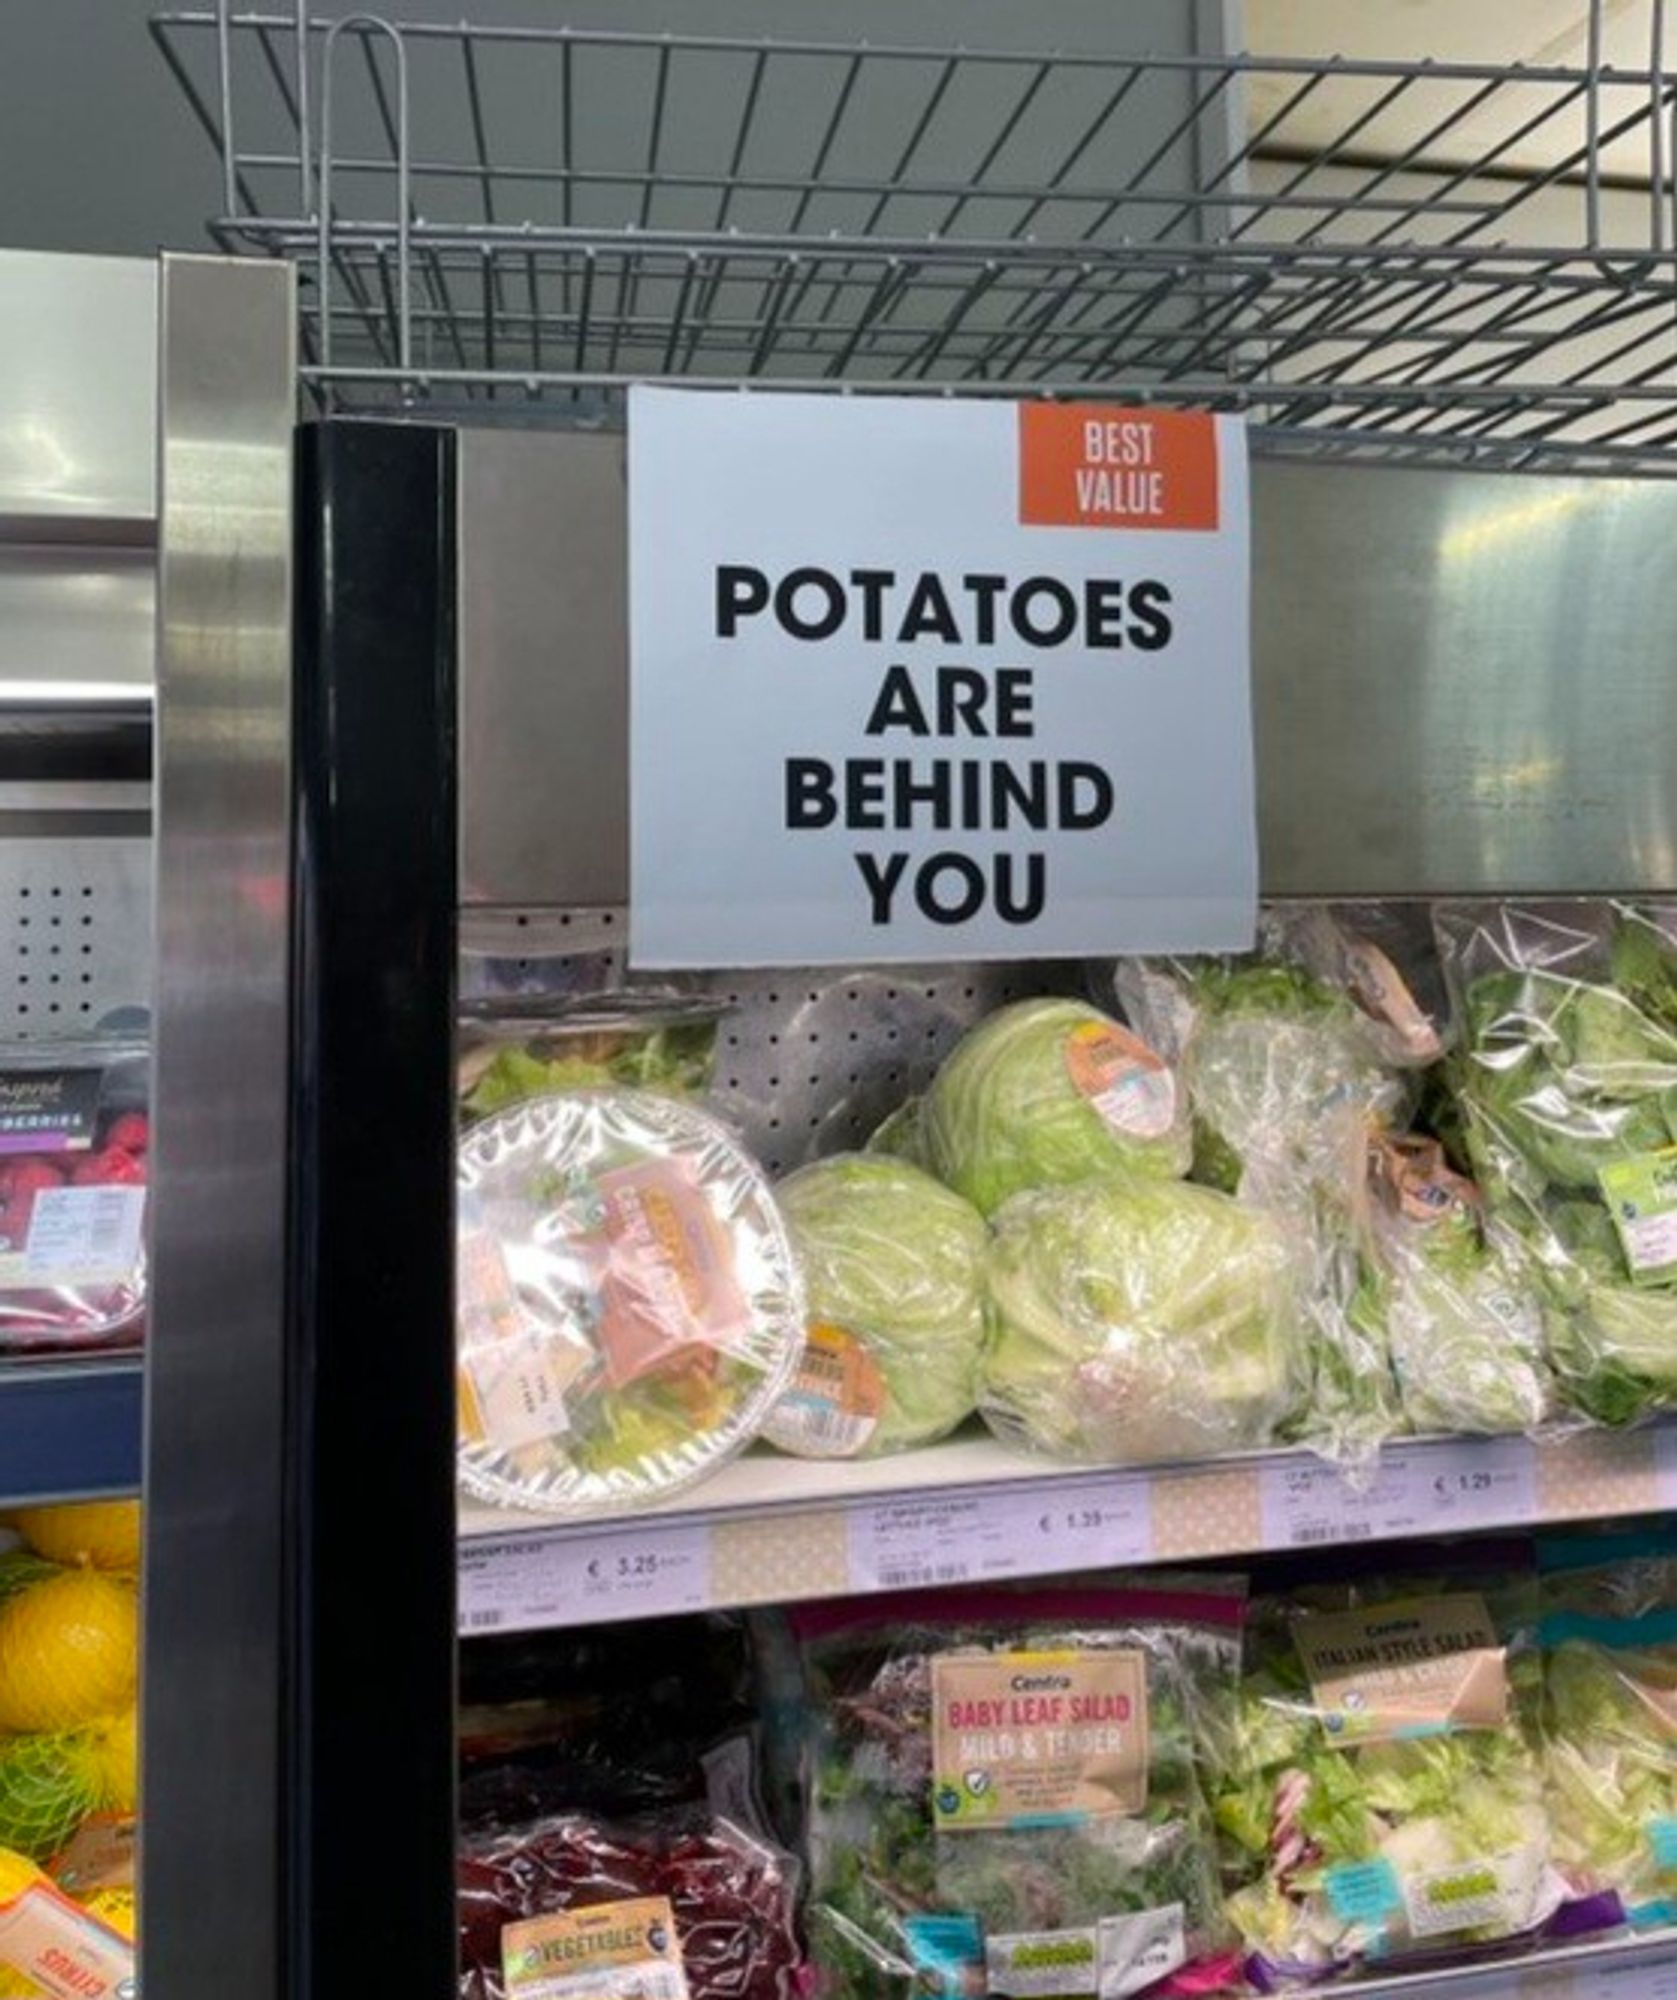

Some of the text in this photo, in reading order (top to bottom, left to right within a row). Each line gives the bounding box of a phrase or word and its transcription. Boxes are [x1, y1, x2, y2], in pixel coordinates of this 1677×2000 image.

[1084, 421, 1154, 465] BEST
[1075, 468, 1164, 516] VALUE
[715, 564, 1172, 651] POTATOES
[865, 665, 1034, 738] ARE
[784, 757, 1114, 831] BEHIND
[853, 851, 1046, 926] YOU
[0, 1112, 82, 1129] BERRIES
[1010, 1674, 1071, 1691] Centra
[949, 1694, 1131, 1729] BABY LEAF SALAD
